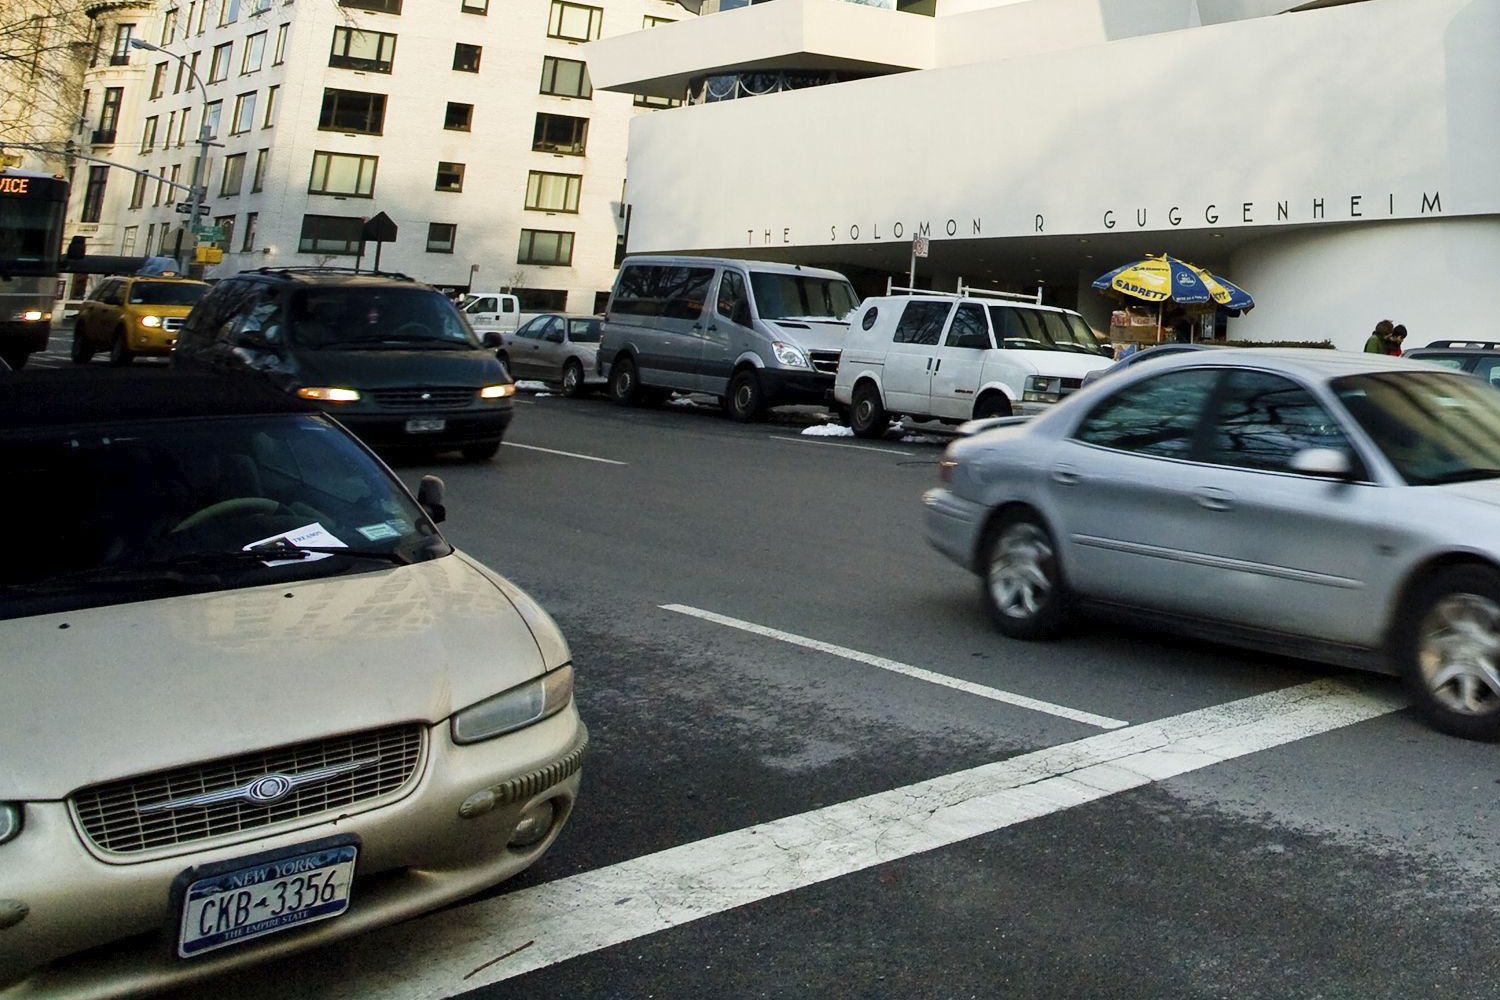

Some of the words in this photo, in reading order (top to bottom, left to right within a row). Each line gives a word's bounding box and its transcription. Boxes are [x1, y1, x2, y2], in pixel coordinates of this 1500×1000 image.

[747, 227, 791, 245] THE
[830, 217, 982, 241] SOLOMON
[1035, 213, 1045, 233] R
[1103, 191, 1443, 229] GUGGENHEIM
[1115, 279, 1168, 300] SABRETT
[230, 868, 268, 889] NEW
[274, 855, 318, 879] YORK
[223, 926, 243, 941] THE
[245, 917, 281, 934] EMPIRE
[282, 910, 309, 925] STATE
